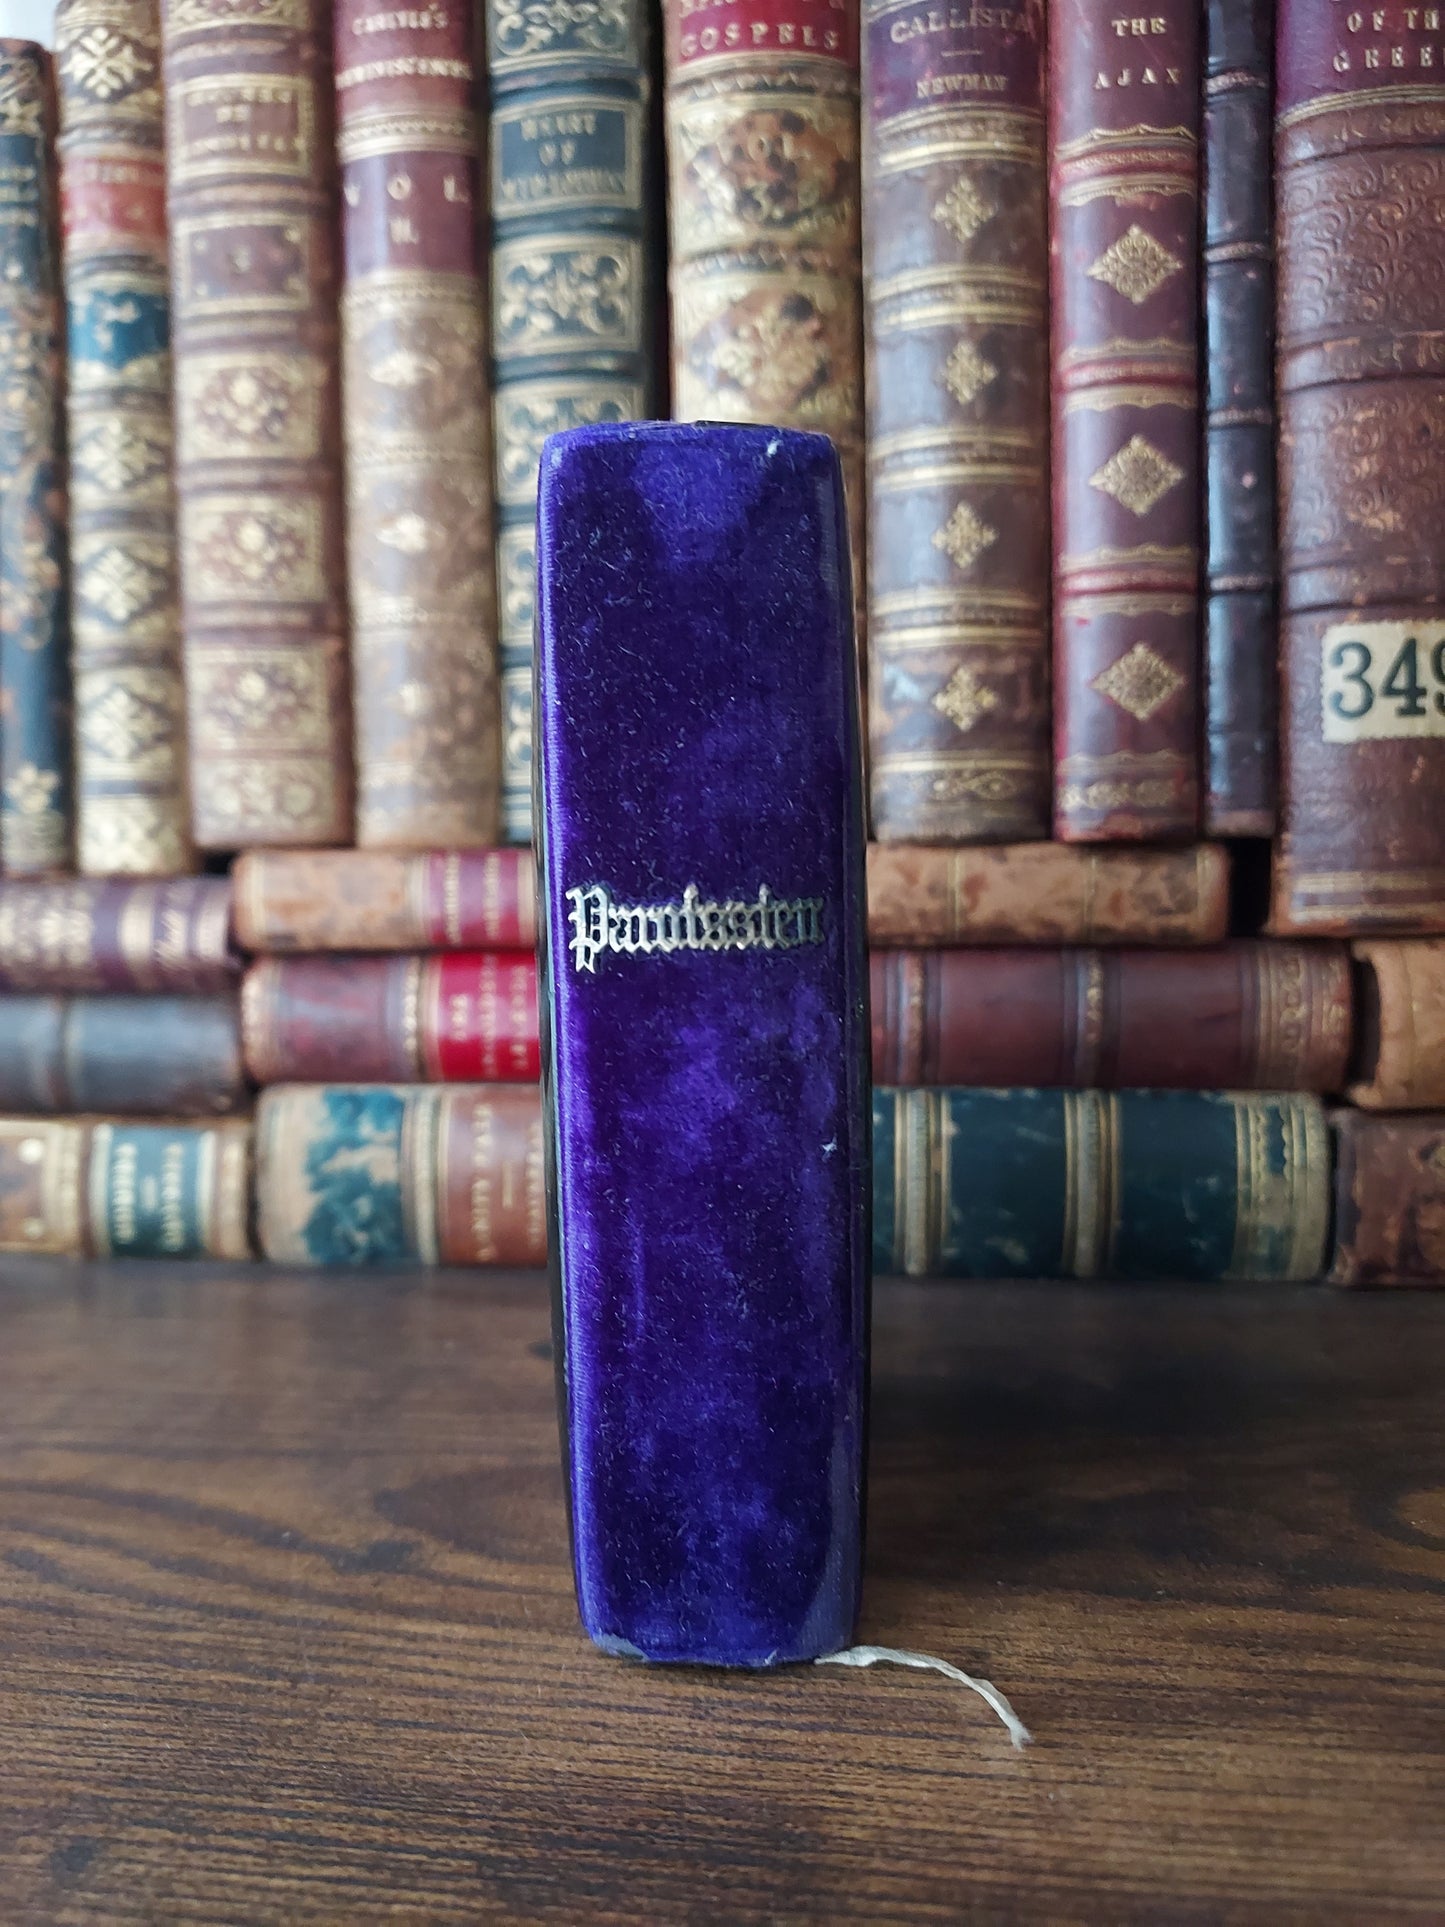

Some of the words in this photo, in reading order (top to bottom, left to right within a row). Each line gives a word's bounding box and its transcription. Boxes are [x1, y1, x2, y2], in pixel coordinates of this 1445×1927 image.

[890, 7, 1033, 44] CALLISTA
[1111, 17, 1168, 37] THE
[1347, 9, 1385, 33] OF
[681, 22, 840, 57] GOSPELS
[1332, 46, 1445, 73] GREE
[916, 73, 1009, 99] NEWMAN
[1094, 67, 1184, 91] AJAX
